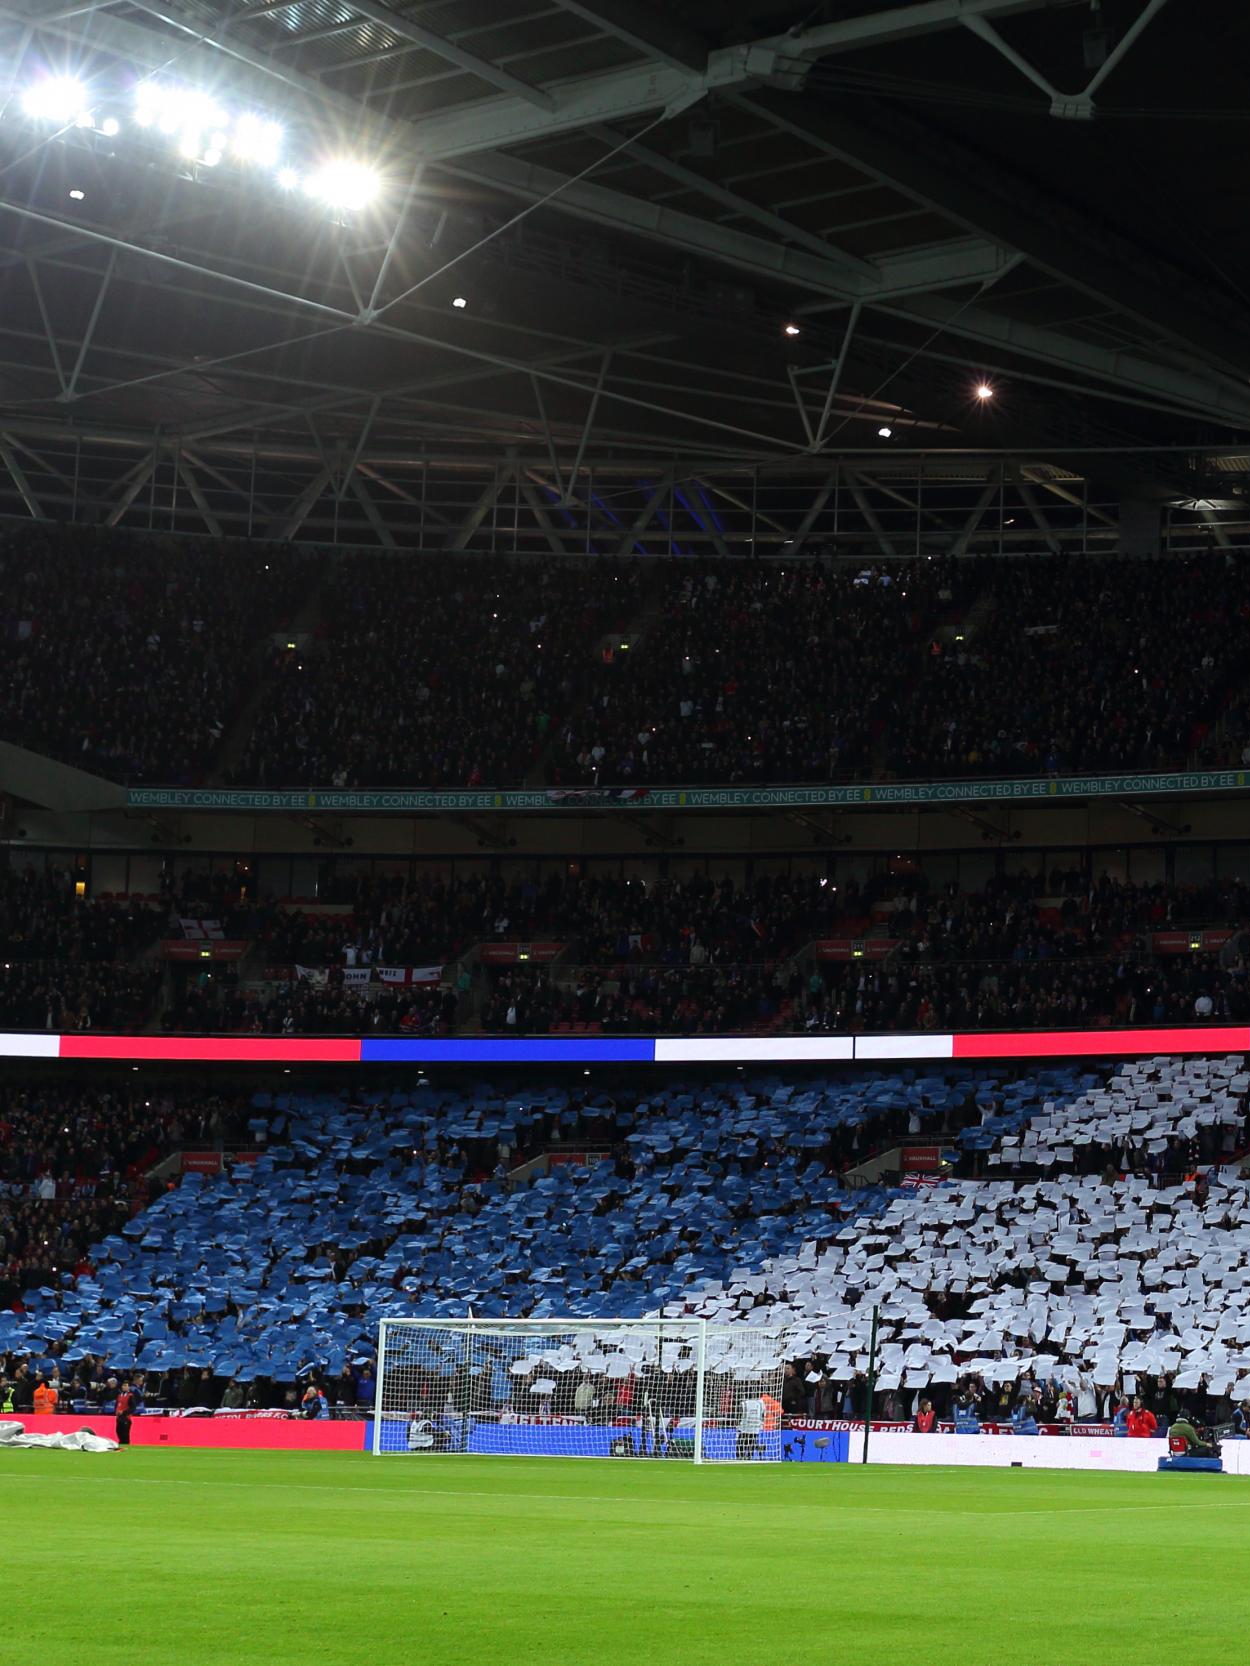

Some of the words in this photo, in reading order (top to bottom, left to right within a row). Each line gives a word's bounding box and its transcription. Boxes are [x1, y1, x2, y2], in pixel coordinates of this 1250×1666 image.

[876, 786, 936, 799] WEMBLEY
[937, 783, 1010, 797] CONNECTED
[1012, 783, 1028, 795] BY
[1033, 782, 1047, 794] EE
[1061, 780, 1120, 793] WEMBLEY
[1123, 777, 1200, 790] CONNECTED
[1202, 776, 1218, 787] BY
[1220, 775, 1234, 786] EE
[130, 791, 190, 804] WEMBLEY
[191, 792, 270, 805] CONNECTED
[273, 793, 289, 805] BY
[290, 794, 305, 806] EE
[320, 794, 379, 806] WEMBLEY
[381, 794, 458, 806] CONNECTED
[460, 795, 476, 806] BY
[478, 795, 491, 806] EE
[662, 794, 676, 805] EE
[691, 791, 749, 804] WEMBLEY
[751, 789, 829, 803] CONNECTED
[830, 788, 846, 801] BY
[847, 787, 860, 800] EE
